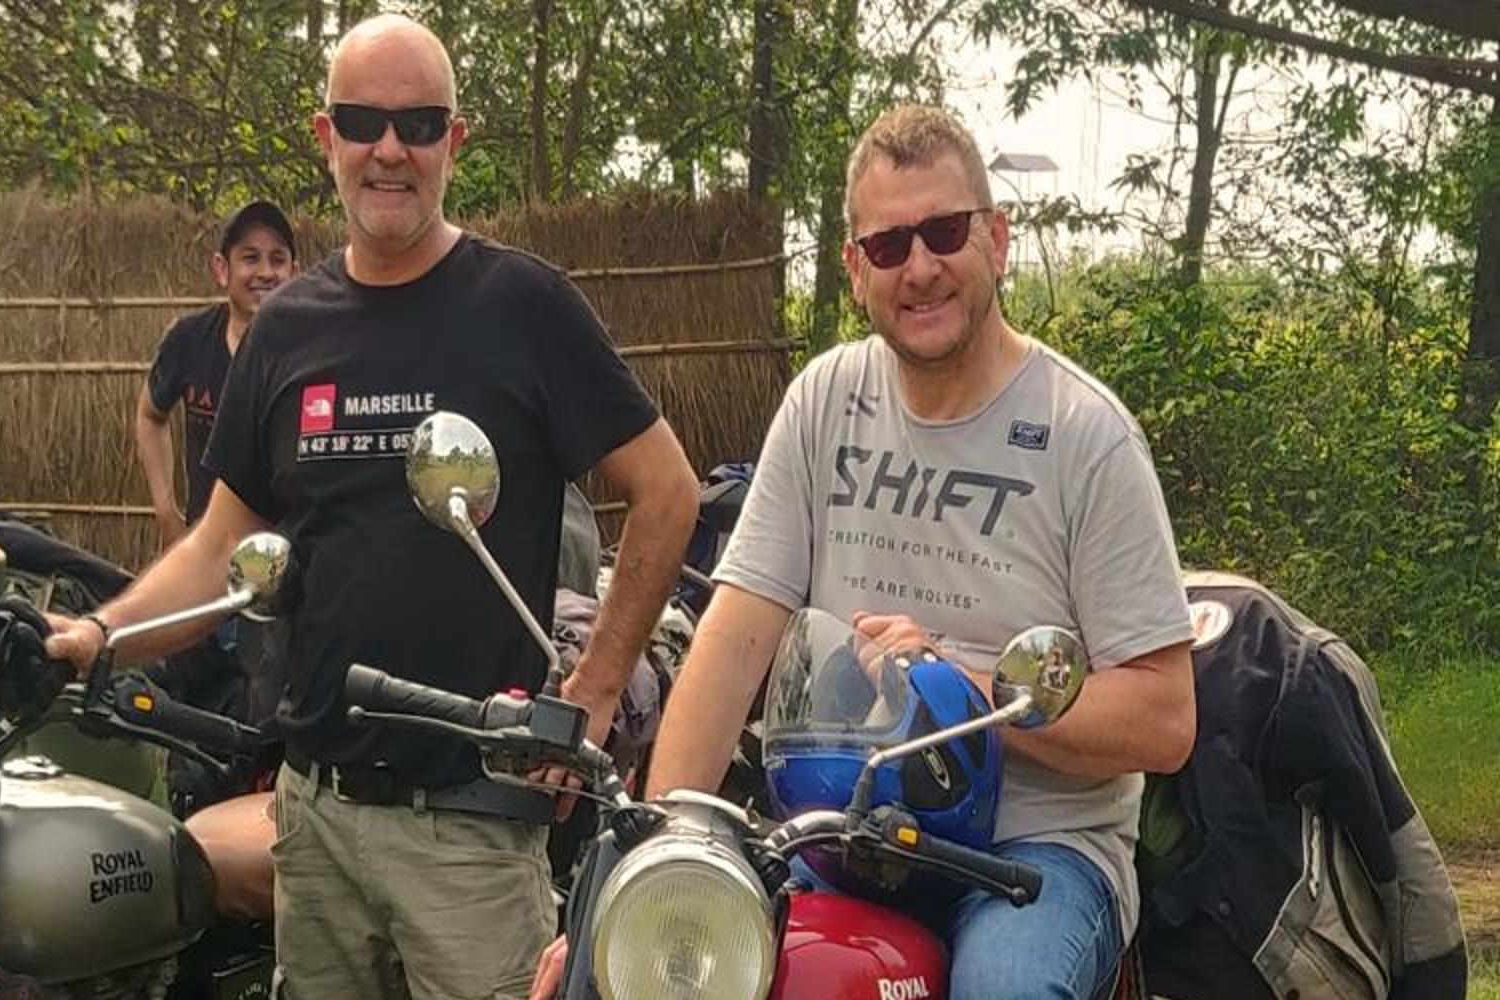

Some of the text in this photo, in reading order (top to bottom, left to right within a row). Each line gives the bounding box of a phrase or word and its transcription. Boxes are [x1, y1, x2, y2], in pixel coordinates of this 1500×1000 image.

[345, 394, 435, 416] MARSEILLE
[379, 435, 387, 450] E
[827, 446, 1035, 536] SHIFT
[901, 540, 931, 557] FOR
[935, 546, 965, 564] THE
[971, 553, 1013, 574] FAST
[875, 579, 910, 598] ARE
[91, 849, 146, 876] ROYAL
[89, 871, 153, 903] ENFIELD
